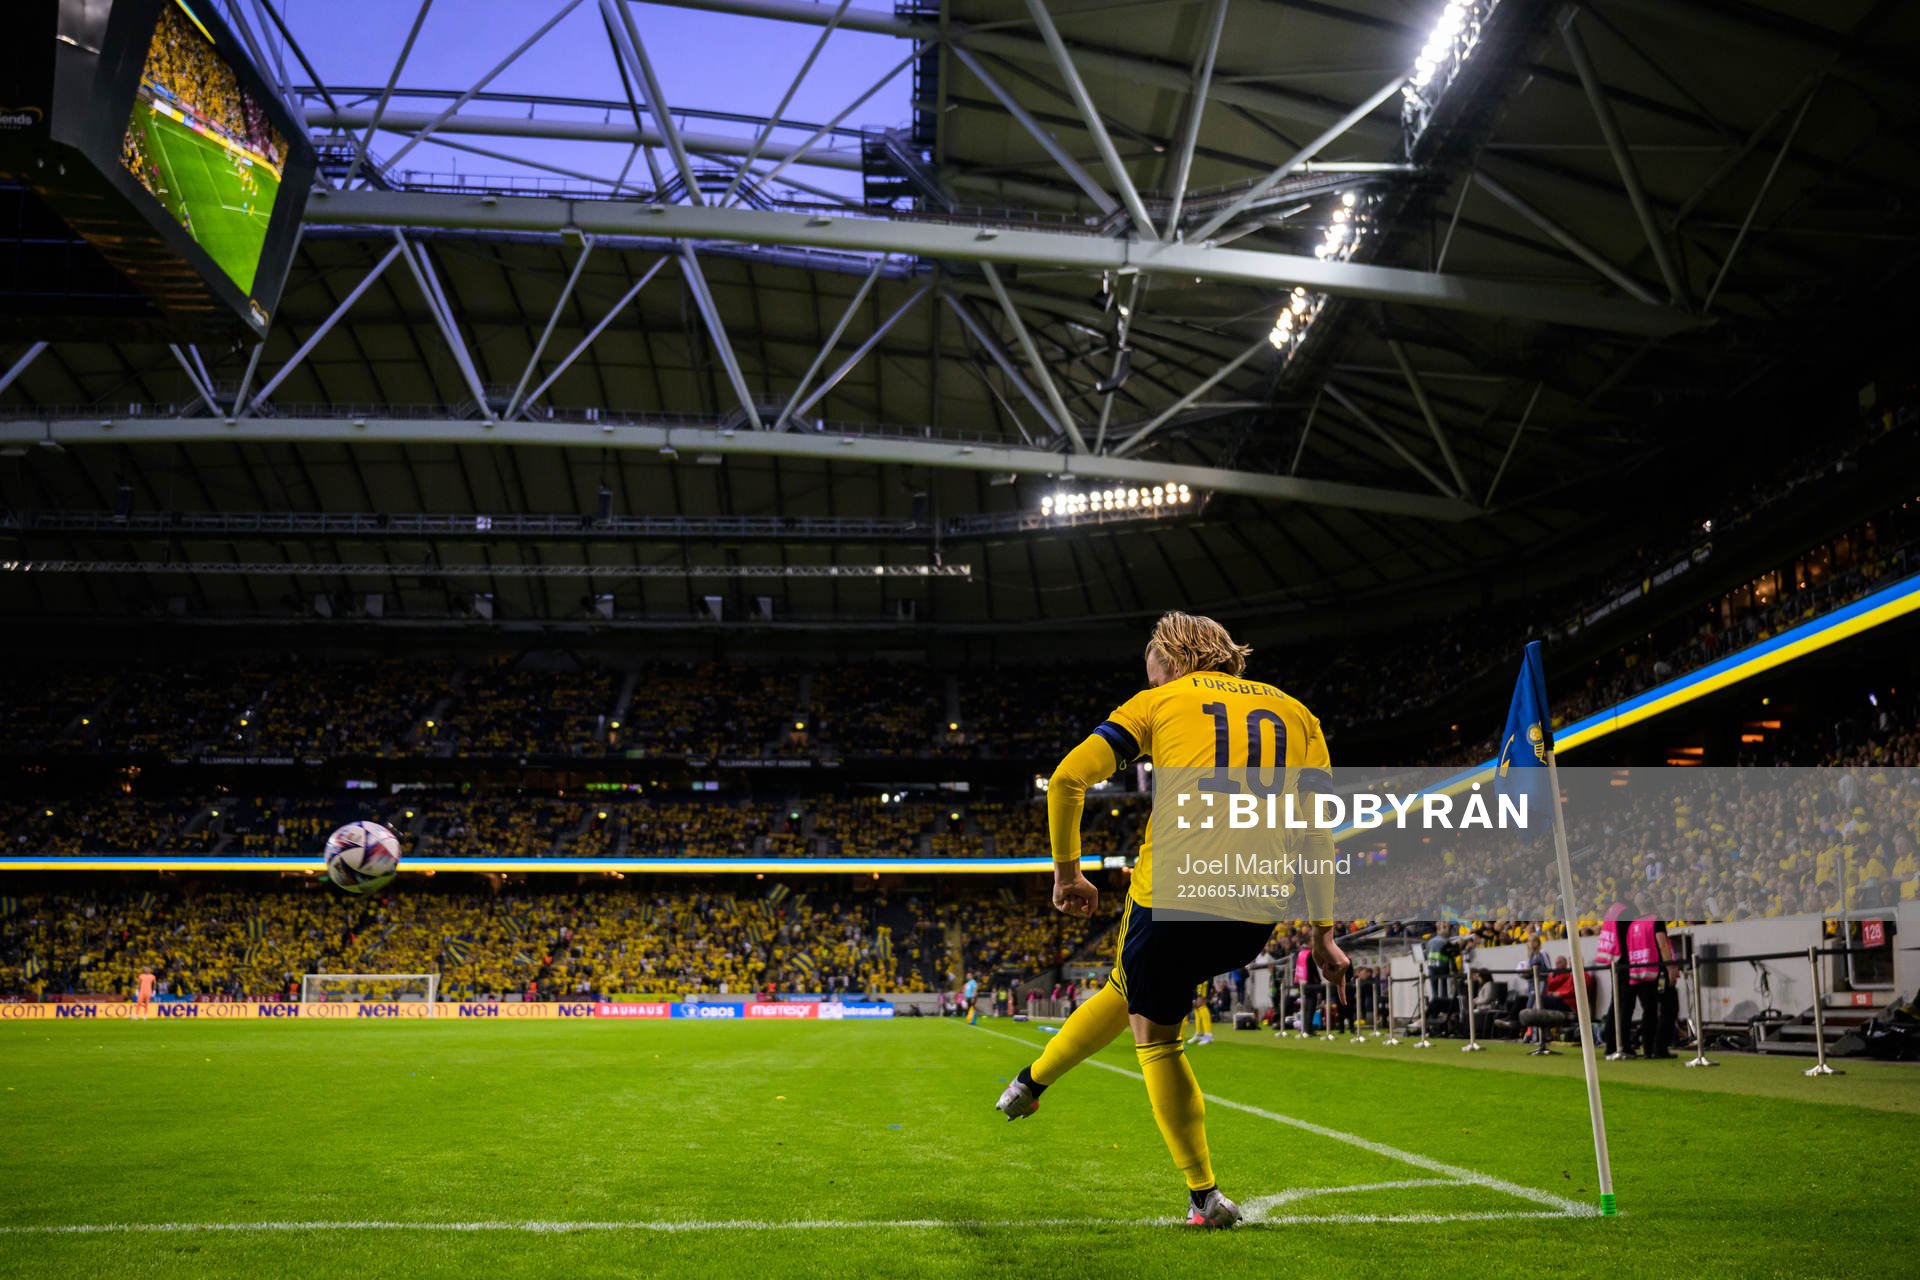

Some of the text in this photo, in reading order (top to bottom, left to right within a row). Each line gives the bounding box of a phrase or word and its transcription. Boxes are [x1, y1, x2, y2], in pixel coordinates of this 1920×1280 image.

[1198, 701, 1287, 798] 10
[1864, 923, 1882, 940] 128
[601, 1005, 664, 1016] BAUHAUS
[700, 1007, 735, 1017] OBOS
